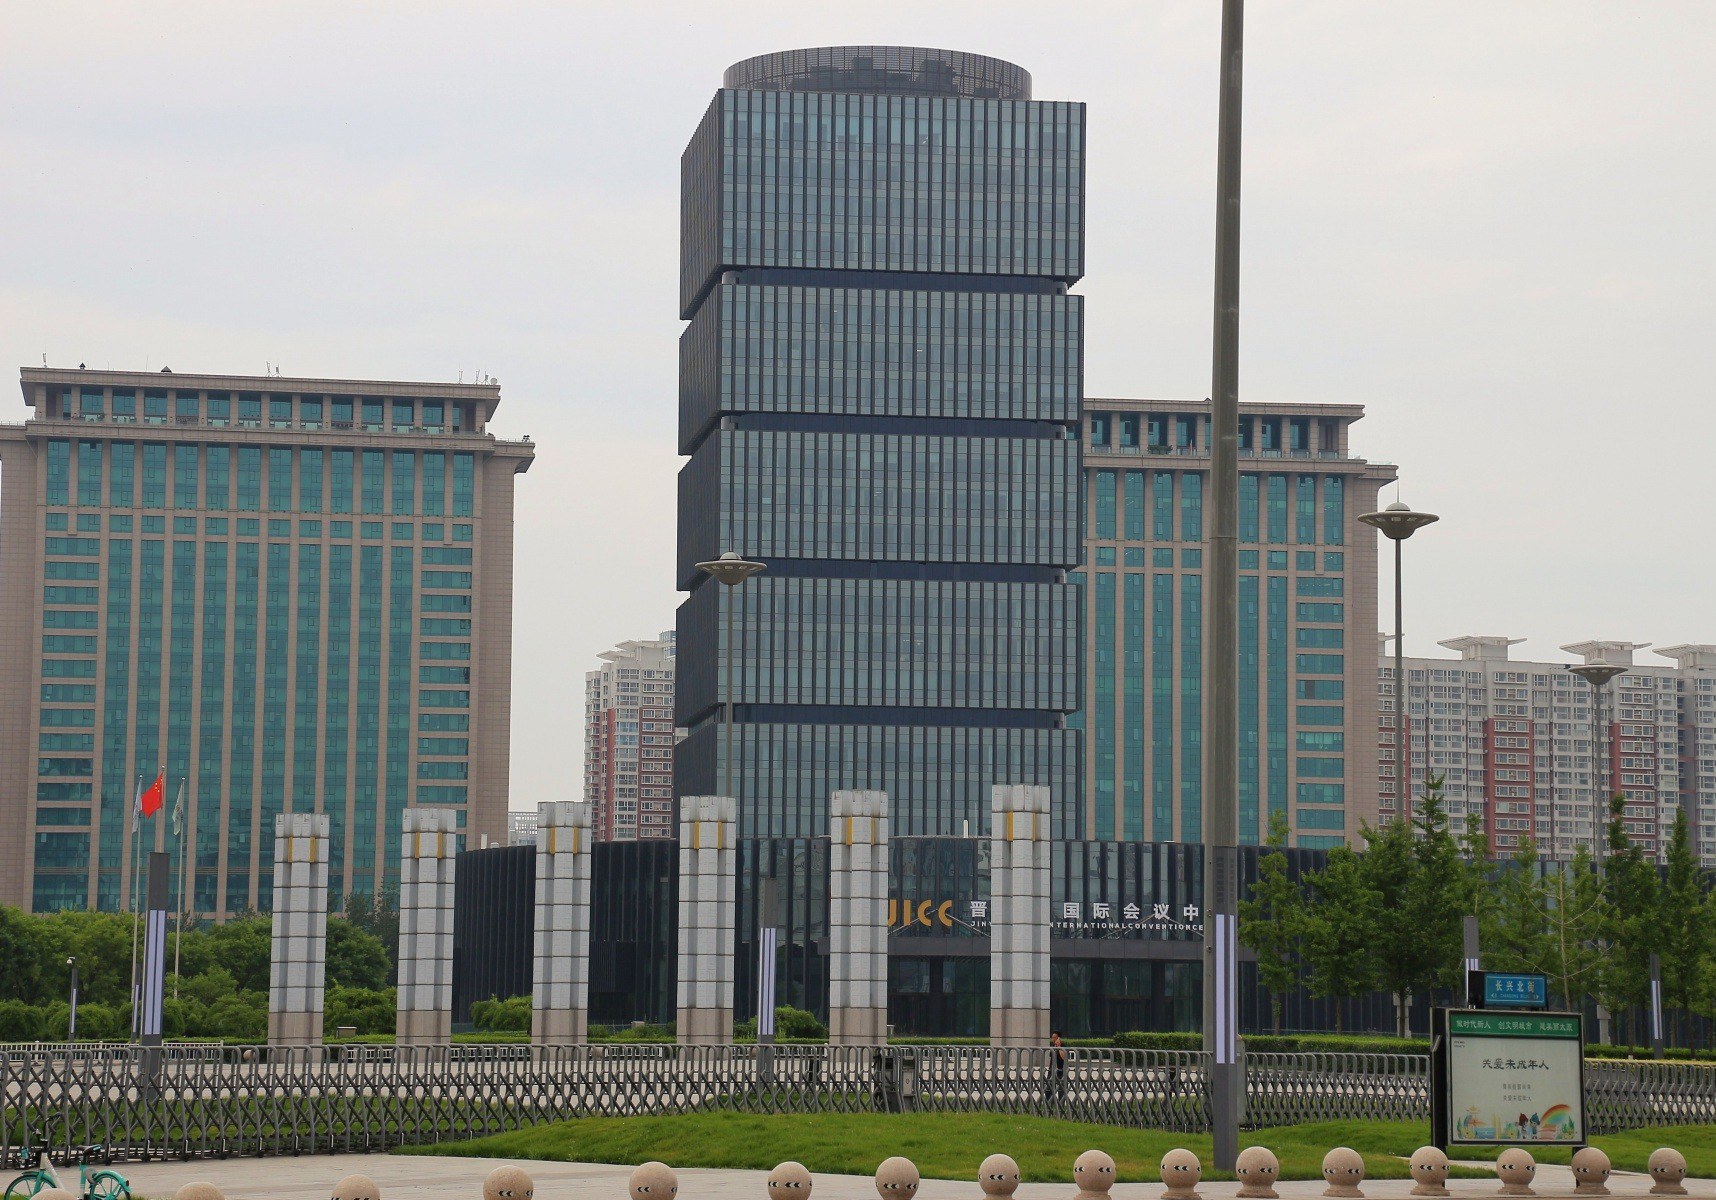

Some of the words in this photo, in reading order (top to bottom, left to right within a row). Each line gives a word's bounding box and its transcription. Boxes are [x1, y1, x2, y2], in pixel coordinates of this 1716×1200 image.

[1482, 1058, 1550, 1070] 关爱未成年人
